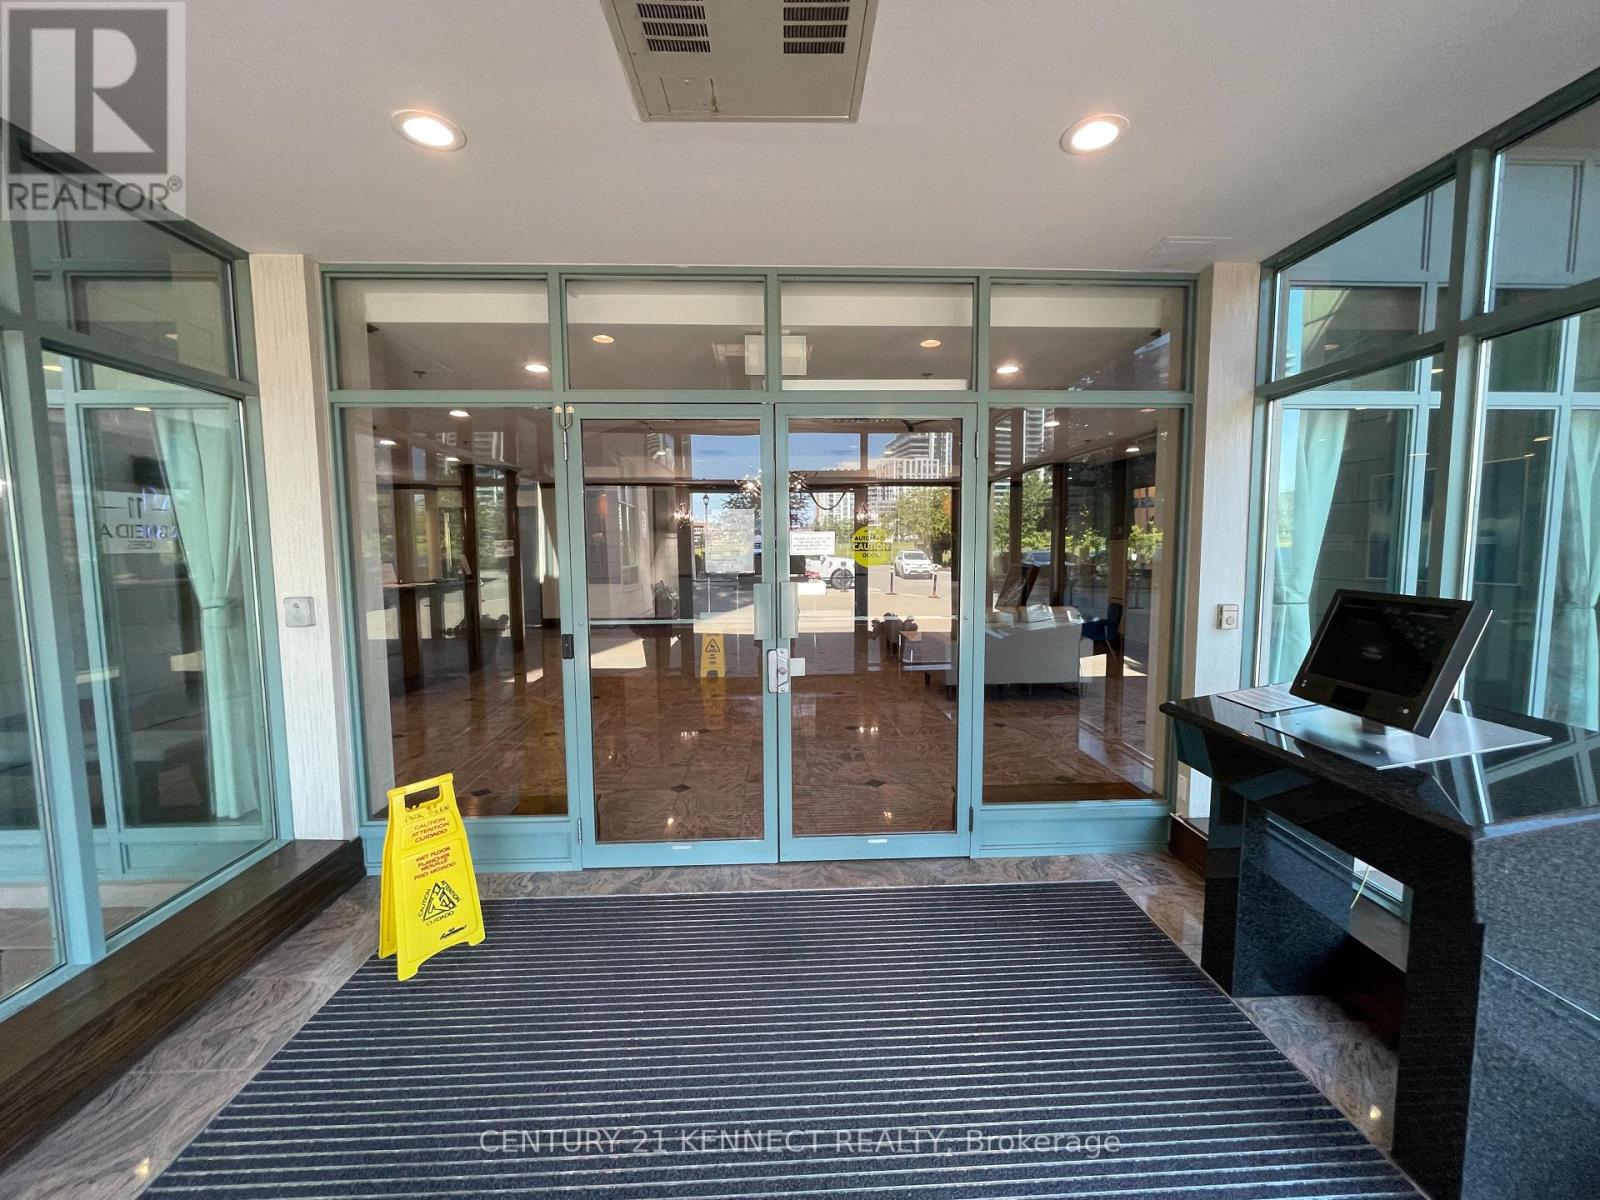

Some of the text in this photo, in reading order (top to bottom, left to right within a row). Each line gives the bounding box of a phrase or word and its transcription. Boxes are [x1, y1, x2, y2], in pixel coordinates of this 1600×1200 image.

[853, 541, 891, 551] CAUTION
[411, 822, 450, 838] ATTENTION
[414, 816, 446, 831] CAUTION
[414, 828, 448, 843] CUIDADO
[441, 880, 462, 903] ATTENTION
[418, 888, 431, 917] CAUTION
[426, 910, 455, 927] CUIDADO
